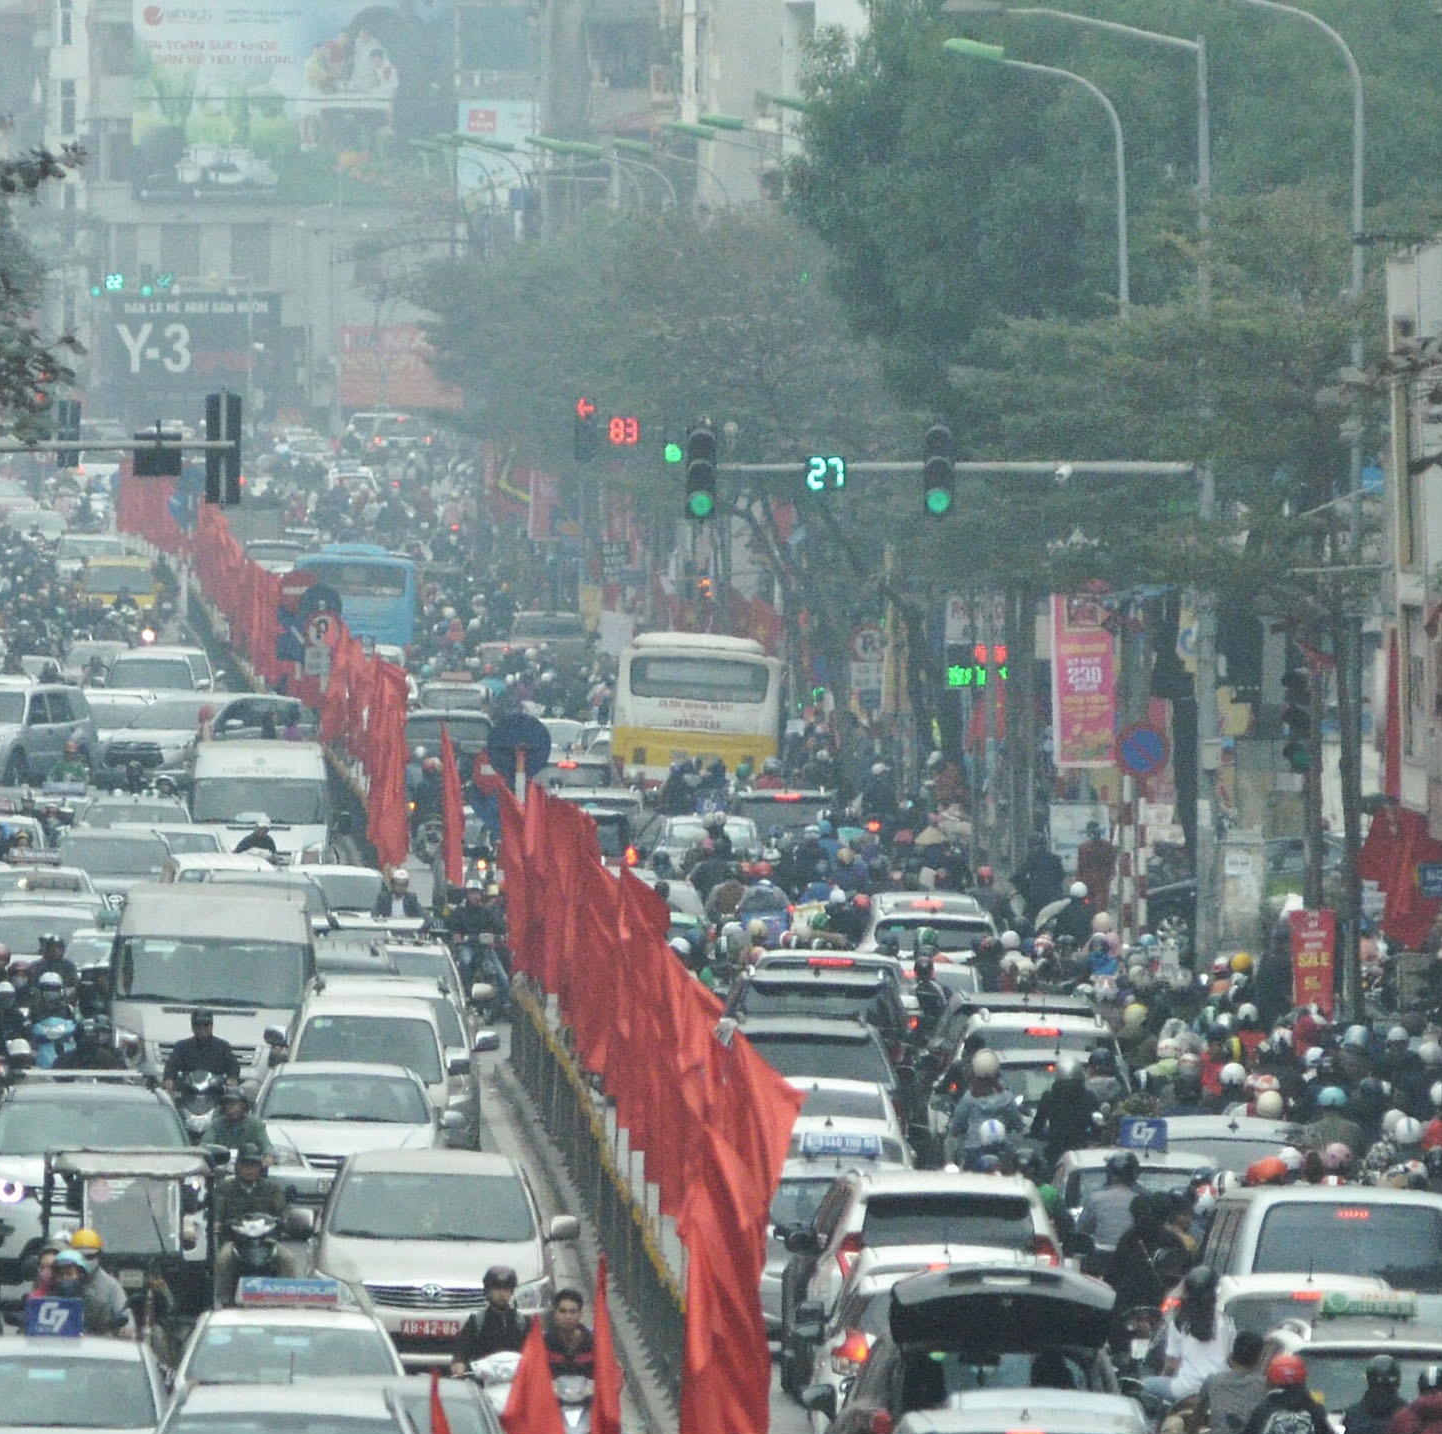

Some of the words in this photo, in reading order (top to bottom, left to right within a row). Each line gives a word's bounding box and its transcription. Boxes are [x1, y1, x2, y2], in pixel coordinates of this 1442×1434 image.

[115, 322, 192, 374] Y-3
[609, 416, 640, 445] 83
[806, 456, 845, 491] 27
[1130, 1121, 1159, 1143] G7
[38, 1301, 71, 1334] G7
